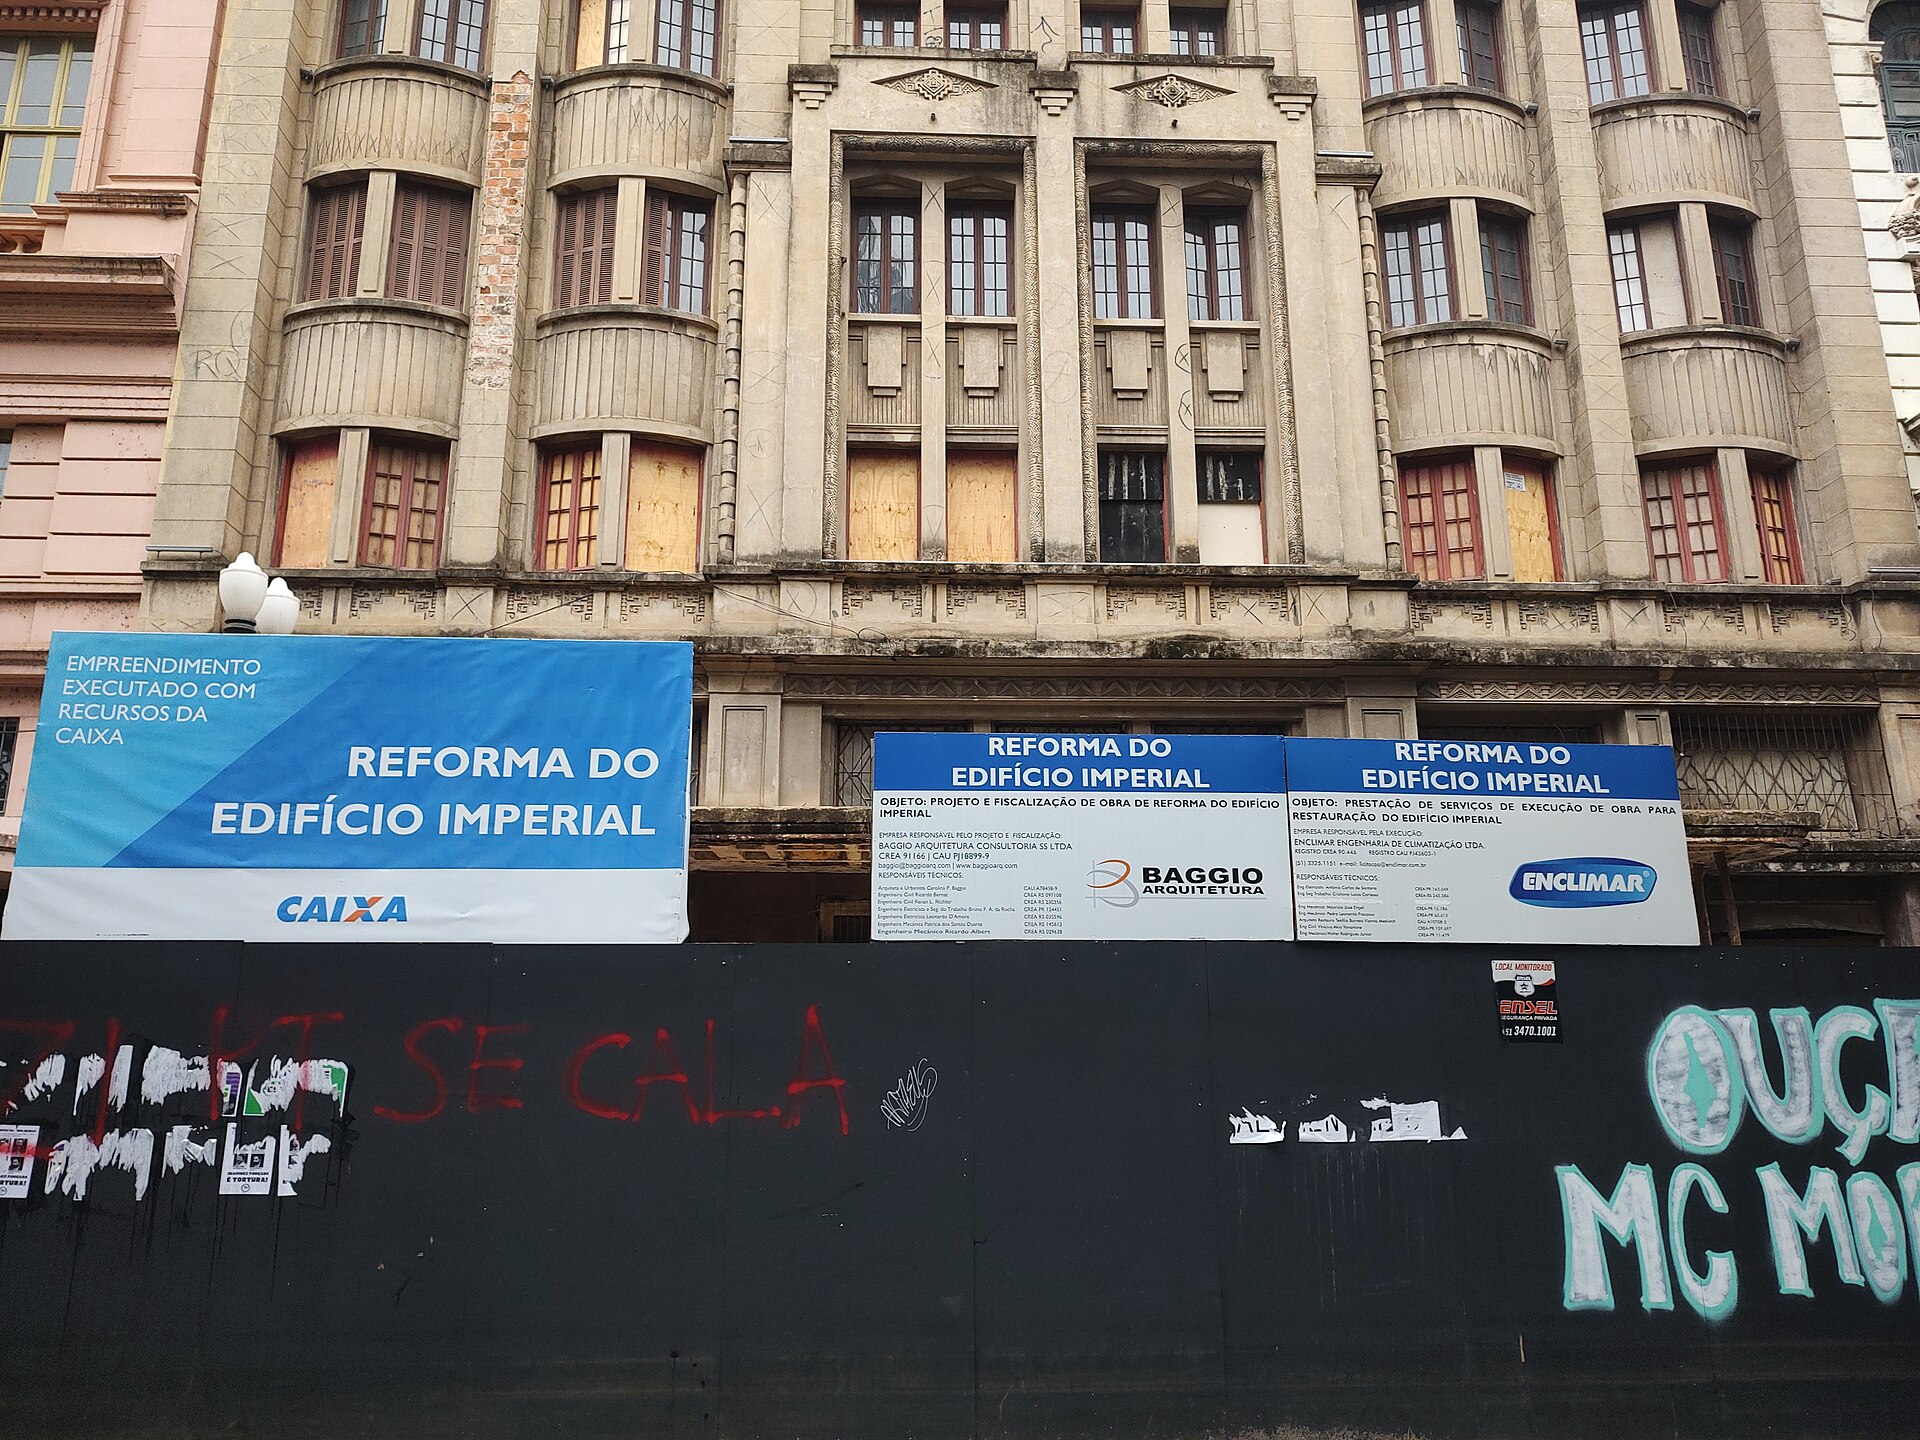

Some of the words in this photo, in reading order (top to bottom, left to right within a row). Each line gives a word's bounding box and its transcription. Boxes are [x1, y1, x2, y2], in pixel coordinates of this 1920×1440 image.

[66, 656, 261, 676] EMPREENDIMENTO
[62, 679, 198, 698] EXECUTADO
[204, 682, 256, 699] COM
[58, 703, 170, 721] RECURSOS
[176, 706, 208, 722] DA
[55, 727, 124, 745] CAIXA
[988, 737, 1122, 757] REFORMA
[1129, 738, 1172, 758] DO
[1395, 742, 1523, 764] REFORMA
[1529, 745, 1571, 765] DO
[348, 746, 575, 778] REFORMA
[589, 747, 660, 779] DO
[952, 762, 1074, 787] EDIFÍCIO
[1082, 768, 1210, 788] IMPERIAL
[1362, 766, 1480, 791] EDIFÍCIO
[1486, 772, 1610, 794] IMPERIAL
[880, 797, 927, 807] OBJETO:
[931, 797, 979, 807] PROJETO
[984, 798, 990, 806] E
[994, 796, 1076, 808] FISCALIZAÇÃO
[1081, 798, 1096, 807] DE
[1100, 799, 1131, 807] OBRA
[1135, 799, 1150, 808] DE
[1153, 799, 1207, 808] REFORMA
[1210, 800, 1228, 808] DO
[1231, 798, 1280, 809] EDIFÍCIO
[1292, 798, 1338, 809] OBJETO:
[1345, 798, 1411, 810] PRESTAÇÃO
[1418, 801, 1433, 809] DE
[1440, 801, 1493, 811] SERVIÇOS
[1500, 802, 1515, 811] DE
[1522, 802, 1583, 813] EXECUÇÃO
[1590, 804, 1604, 813] DE
[1611, 805, 1641, 814] OBRA
[1649, 806, 1676, 815] PARA
[211, 794, 424, 835] EDIFÍCIO
[438, 803, 656, 836] IMPERIAL
[880, 809, 932, 818] IMPERIAL
[1292, 811, 1376, 823] RESTAURAÇÃO
[1382, 813, 1399, 822] DO
[1402, 812, 1449, 824] EDIFÍCIO
[1452, 815, 1503, 825] IMPERIAL
[909, 831, 955, 839] RESPONSÁVEL
[975, 832, 1004, 840] PROJETO
[1012, 831, 1062, 840] FISCALIZAÇÃO:
[1323, 828, 1367, 836] RESPONSÁVEL
[1385, 829, 1424, 838] EXECUÇÃO:
[878, 842, 913, 850] BAGGIO
[915, 842, 974, 851] ARQUITETURA
[976, 842, 1038, 851] CONSULTORIA
[1039, 843, 1048, 851] SS
[1050, 843, 1072, 851] LTDA
[1294, 838, 1335, 847] ENCLIMAR
[1337, 839, 1390, 848] ENGENHARIA
[1391, 840, 1402, 848] DE
[1404, 839, 1462, 850] CLIMATIZAÇÃO
[1465, 841, 1486, 849] LTDA.
[878, 852, 901, 860] CREA
[903, 852, 926, 860] 91166
[933, 852, 951, 860] CAU
[878, 862, 951, 870] baggio@baggioarq.com
[878, 871, 926, 879] RESPONSÁVEIS
[1142, 866, 1263, 884] BAGGIO
[1296, 873, 1343, 881] RESPONSÁVEIS
[1522, 872, 1645, 893] ENCLIMAR
[1142, 885, 1264, 895] ARQUITETURA
[276, 895, 408, 923] CAIXA
[1495, 962, 1513, 971] LOCAL
[1515, 963, 1553, 972] MONITORADO
[1513, 1026, 1556, 1037] 3470.1001
[373, 1016, 528, 1122] SE
[562, 1003, 849, 1135] CALA
[1554, 1161, 1739, 1322] MC
